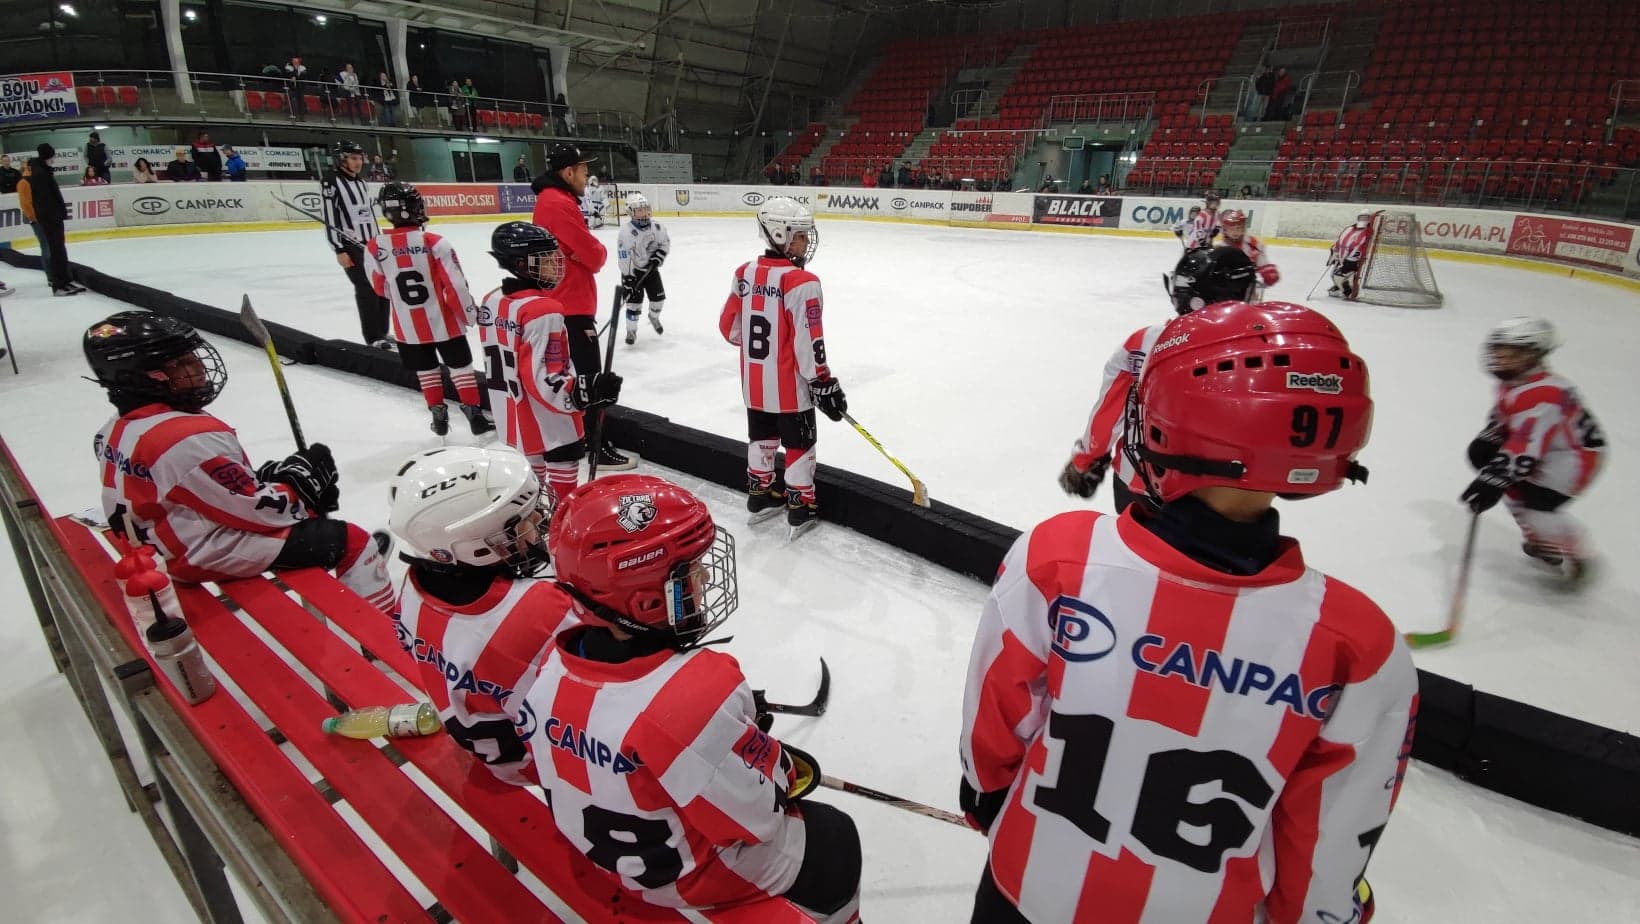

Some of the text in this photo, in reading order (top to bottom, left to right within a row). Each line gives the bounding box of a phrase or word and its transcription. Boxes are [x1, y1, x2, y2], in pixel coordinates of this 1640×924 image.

[2, 80, 39, 99] BOJU
[0, 98, 65, 116] WIADKI!
[175, 198, 244, 210] CANPACK
[458, 193, 496, 207] POLSKI
[827, 194, 880, 210] MAXXX
[910, 200, 945, 210] CANPACK
[1047, 199, 1104, 216] BLACK
[395, 270, 430, 306] 6
[1153, 332, 1191, 354] Reebok
[1289, 373, 1341, 388] Reebok
[1289, 404, 1344, 450] 97
[421, 471, 478, 499] CCM
[617, 547, 665, 571] BAUER
[1032, 710, 1275, 874] 16
